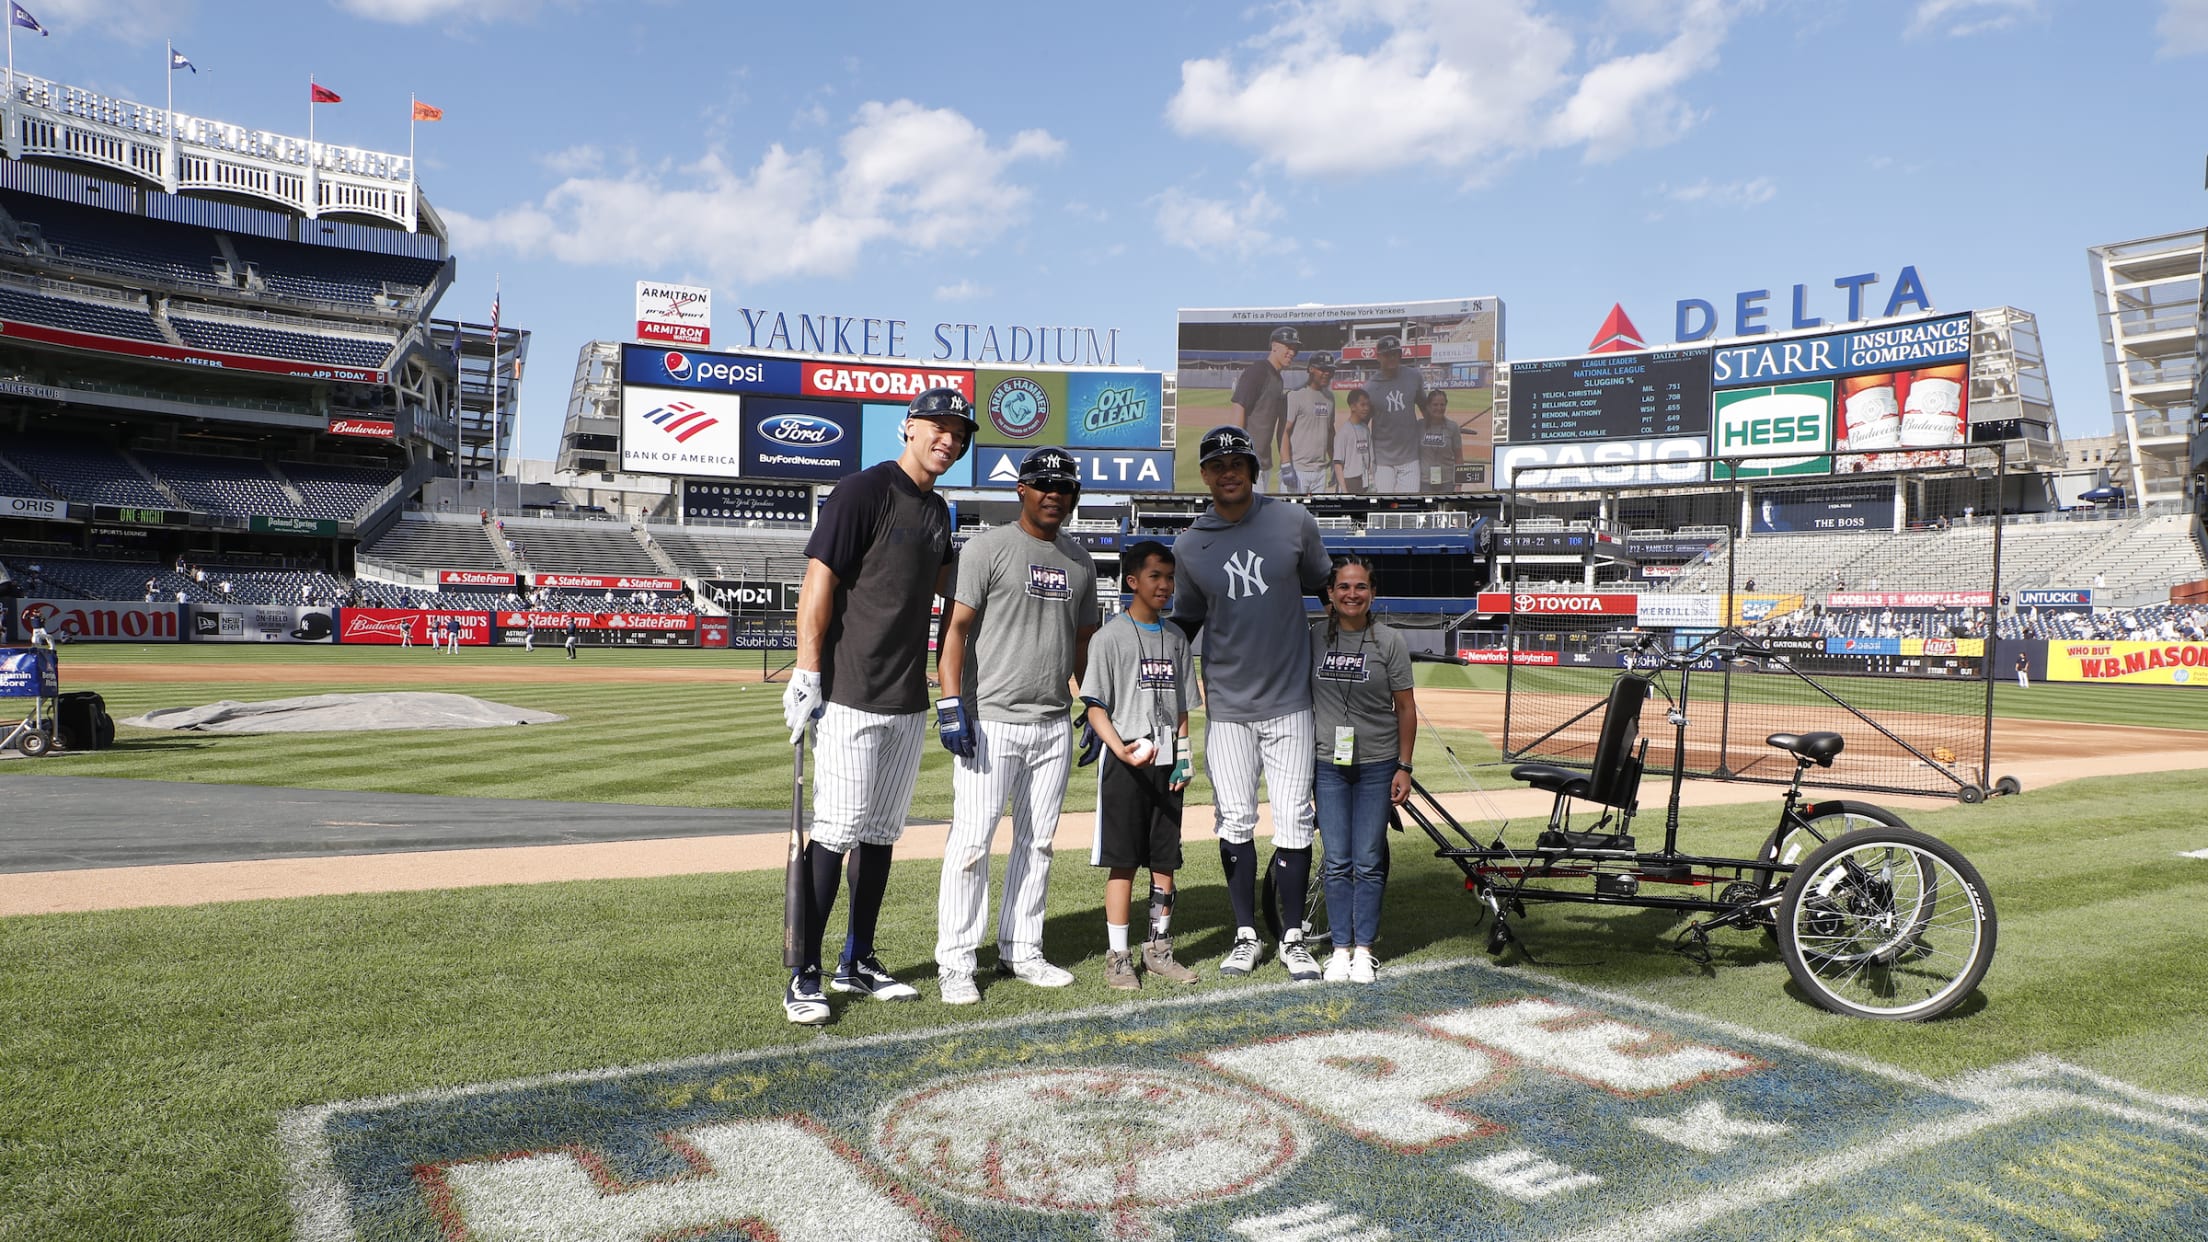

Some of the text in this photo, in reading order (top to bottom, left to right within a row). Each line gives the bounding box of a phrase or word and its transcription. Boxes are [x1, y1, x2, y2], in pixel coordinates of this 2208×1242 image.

[642, 288, 707, 303] ARMITRON
[1675, 265, 1934, 343] DELTA
[1266, 311, 1287, 319] Proud
[1289, 310, 1317, 318] Partner
[1340, 309, 1356, 317] New
[1357, 308, 1373, 316] York
[1374, 307, 1406, 315] Yankees
[644, 324, 704, 338] ARMITRON
[737, 307, 1120, 366] YANKEE STADIUM
[1853, 318, 1970, 351] INSURANCE
[1652, 350, 1708, 360] DAILY NEWS
[1852, 336, 1970, 367] COMPANIES
[1542, 361, 1567, 369] NEWS
[1582, 357, 1637, 368] LEAGUE LEADERS
[1714, 340, 1838, 381] STARR
[334, 370, 367, 380] TODAY.
[697, 363, 764, 384] pepsi
[1573, 365, 1646, 378] NATIONAL LEAGUE
[813, 369, 965, 395] GATORADE
[1584, 377, 1625, 387] SLUGGING
[0, 382, 60, 398] ANKEES CLUB
[991, 388, 1005, 412] ARM
[1013, 380, 1046, 413] HAMMER
[1542, 391, 1566, 399] YELICH,
[1568, 389, 1602, 397] CHRISTIAN
[1099, 389, 1134, 411] OXI
[1541, 401, 1579, 409] BELLINGER,
[1580, 399, 1597, 407] CODY
[1084, 400, 1146, 431] CLEAN
[1541, 411, 1570, 419] RENDON,
[1571, 409, 1602, 417] ANTHONY
[332, 421, 393, 436] Budweiser
[775, 418, 825, 443] Ford
[1541, 421, 1559, 429] BELL,
[1724, 414, 1820, 447] HESS
[1219, 433, 1233, 447] NY
[1541, 430, 1578, 439] BLACKMON,
[625, 451, 735, 465] BANK OF AMERICA
[759, 453, 840, 467] BuyFordNow.com
[1047, 453, 1060, 468] NY
[1503, 439, 1703, 487] CASIO
[1072, 456, 1161, 482] LTA
[12, 499, 55, 512] ORIS
[722, 497, 774, 508] New York Yankees
[268, 517, 317, 530] Poland Spring
[1814, 517, 1865, 528] THE BOSS
[1100, 537, 1113, 545] TOR
[1504, 537, 1520, 546] SET
[1536, 537, 1545, 546] 22
[1568, 537, 1583, 546] TOR
[1646, 544, 1673, 552] YANKEES
[1033, 569, 1065, 585] HOPE
[1223, 549, 1270, 601] NY
[713, 588, 756, 603] AMD
[1832, 594, 1882, 605] MODELL'S
[1904, 594, 1990, 604] MODELLS.com
[2019, 591, 2079, 604] UNTUCKit
[1537, 597, 1602, 611] TOYOTA
[1640, 607, 1690, 616] MERRILL
[21, 602, 177, 638] Canon
[351, 618, 402, 631] Budweis
[454, 615, 487, 627] BUD'S
[426, 628, 476, 640] FR OU.
[735, 636, 778, 647] StubHub
[1773, 640, 1812, 649] GATORADE
[2066, 646, 2112, 656] WHO BUT
[1326, 655, 1363, 668] HOPE
[0, 671, 32, 680] njamin
[1142, 663, 1174, 676] HOPE
